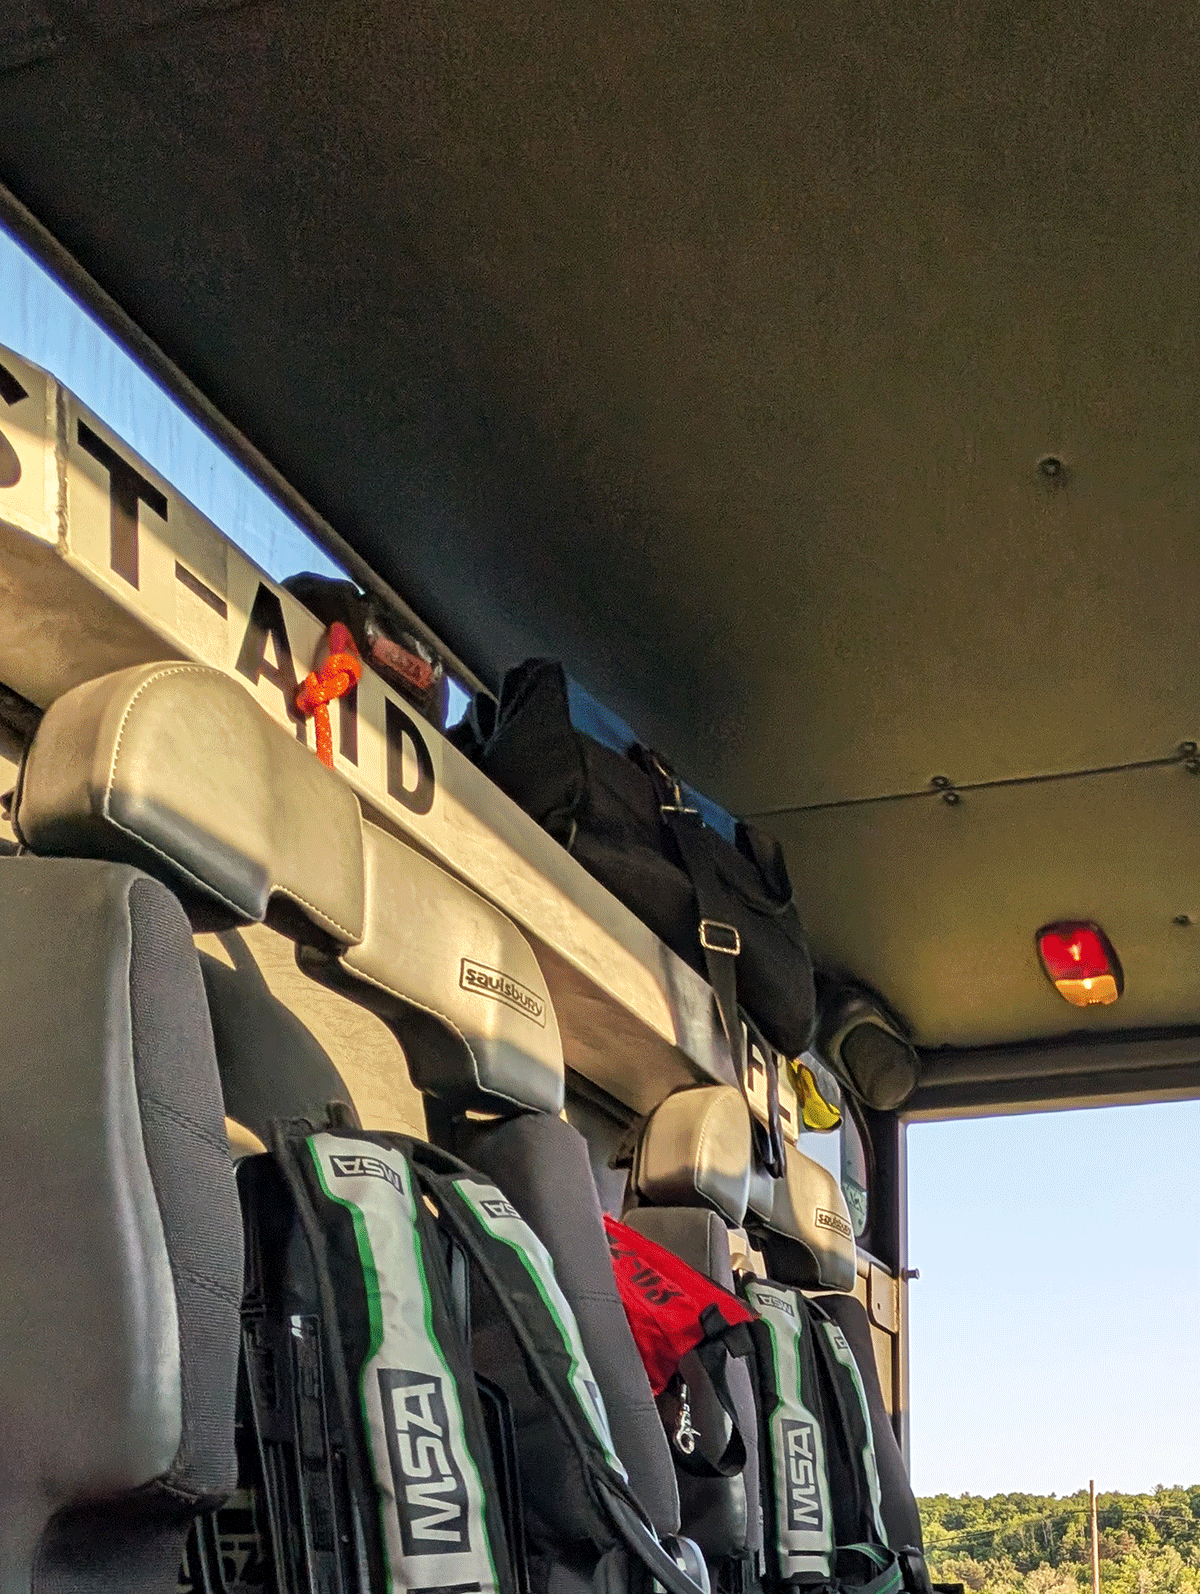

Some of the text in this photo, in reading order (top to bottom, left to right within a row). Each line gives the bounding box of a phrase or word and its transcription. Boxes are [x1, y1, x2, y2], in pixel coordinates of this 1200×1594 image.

[332, 1157, 400, 1190] MSA
[483, 1201, 521, 1219] SA
[761, 1294, 794, 1317] MSA
[391, 1382, 461, 1542] MSA
[787, 1426, 819, 1525] MSA
